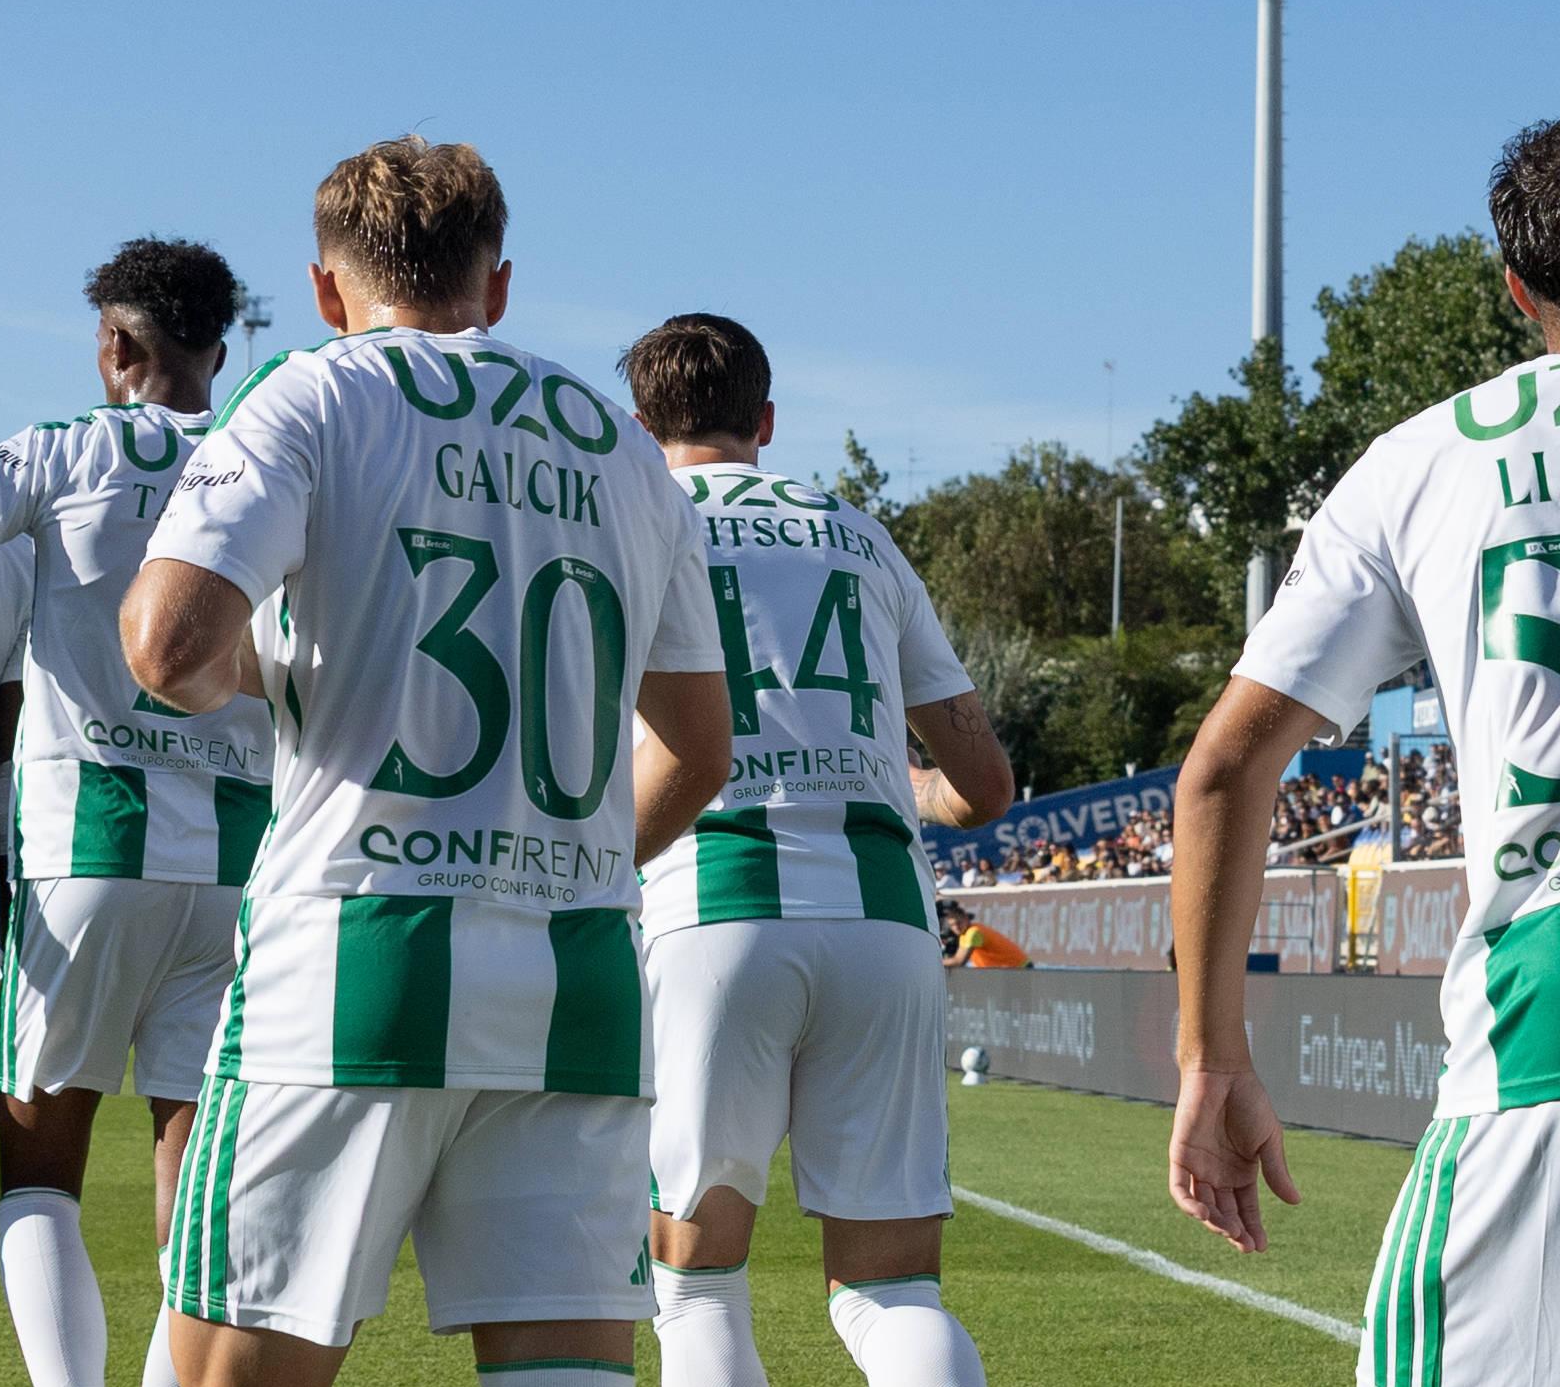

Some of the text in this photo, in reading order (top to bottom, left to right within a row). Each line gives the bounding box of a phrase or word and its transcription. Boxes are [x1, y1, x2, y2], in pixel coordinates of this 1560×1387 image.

[384, 346, 618, 455] UZO
[436, 443, 601, 527] GALCIK
[368, 528, 627, 820] 30
[733, 779, 865, 801] GRUPO CONFIAUTO
[360, 824, 622, 887] CONFIRENT
[417, 872, 576, 904] GRUPO CONFIAUTO
